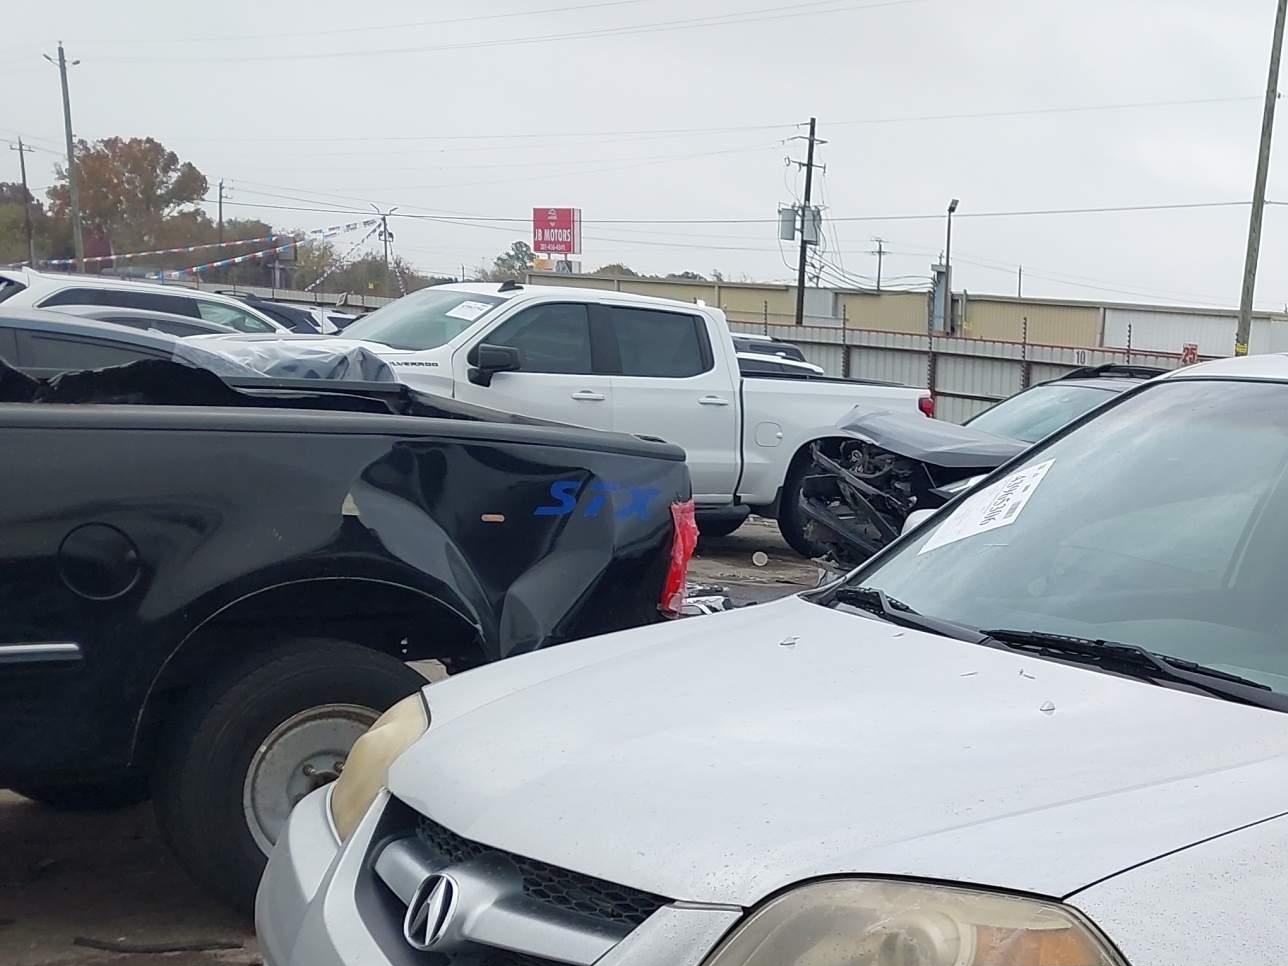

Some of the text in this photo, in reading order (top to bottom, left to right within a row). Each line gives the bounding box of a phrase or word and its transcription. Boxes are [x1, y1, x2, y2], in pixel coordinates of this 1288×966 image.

[535, 229, 571, 241] JB MOTORS
[1076, 351, 1086, 364] 10
[1183, 347, 1197, 364] 25
[533, 480, 660, 522] STX
